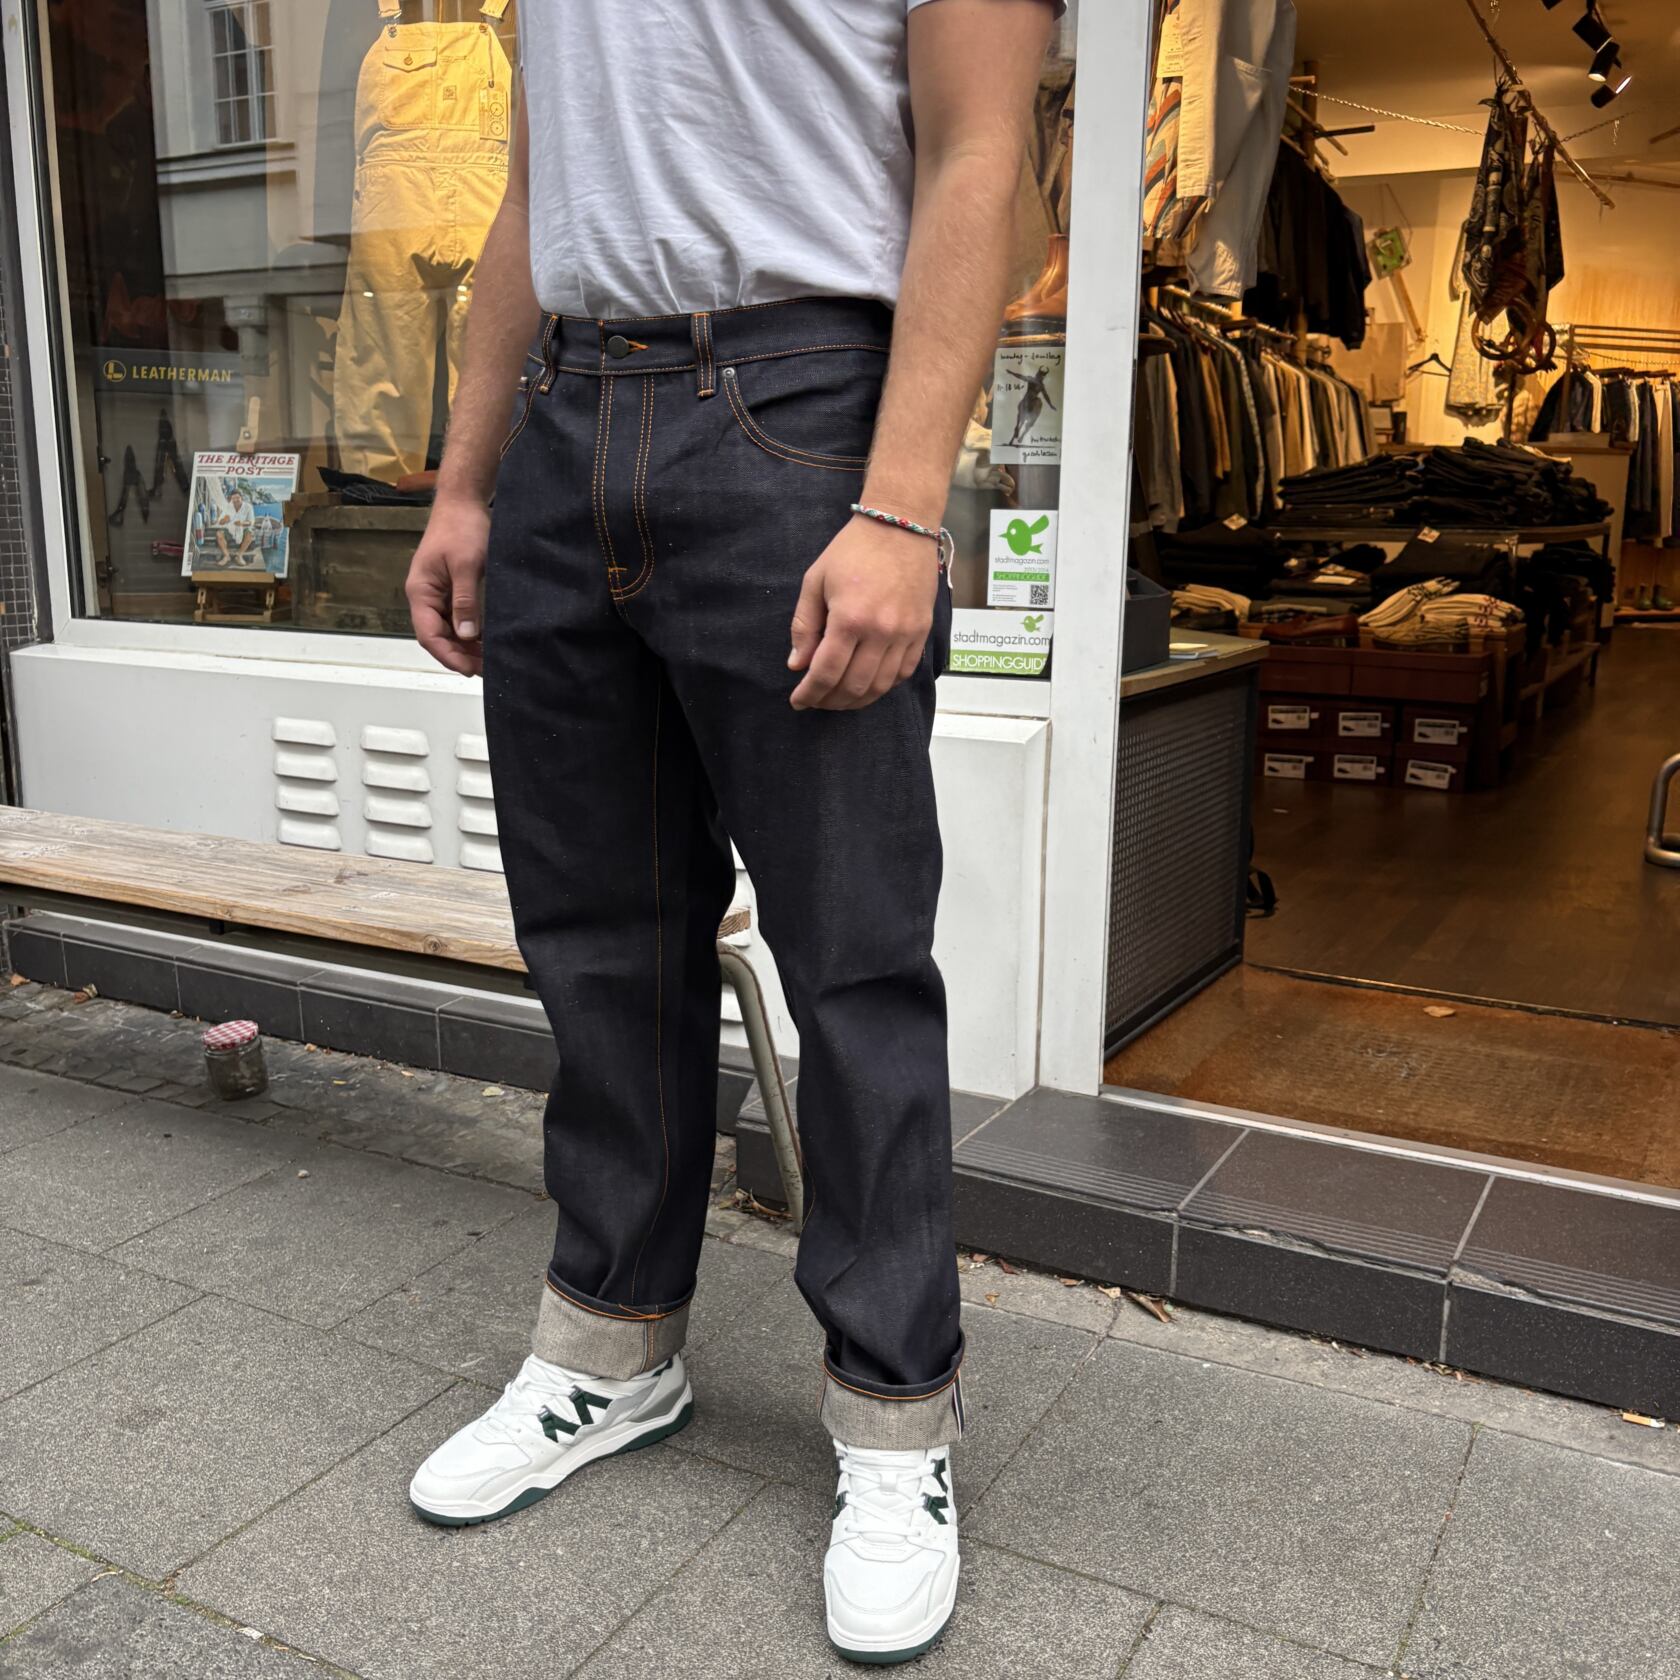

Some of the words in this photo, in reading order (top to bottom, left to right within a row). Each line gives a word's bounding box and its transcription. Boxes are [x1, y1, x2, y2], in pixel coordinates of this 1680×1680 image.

[132, 366, 231, 382] LEATHERMAN
[198, 454, 224, 464] THE
[227, 454, 296, 467] HERITAGE
[225, 466, 264, 476] POST
[953, 629, 1050, 647] stadtmagazin.com
